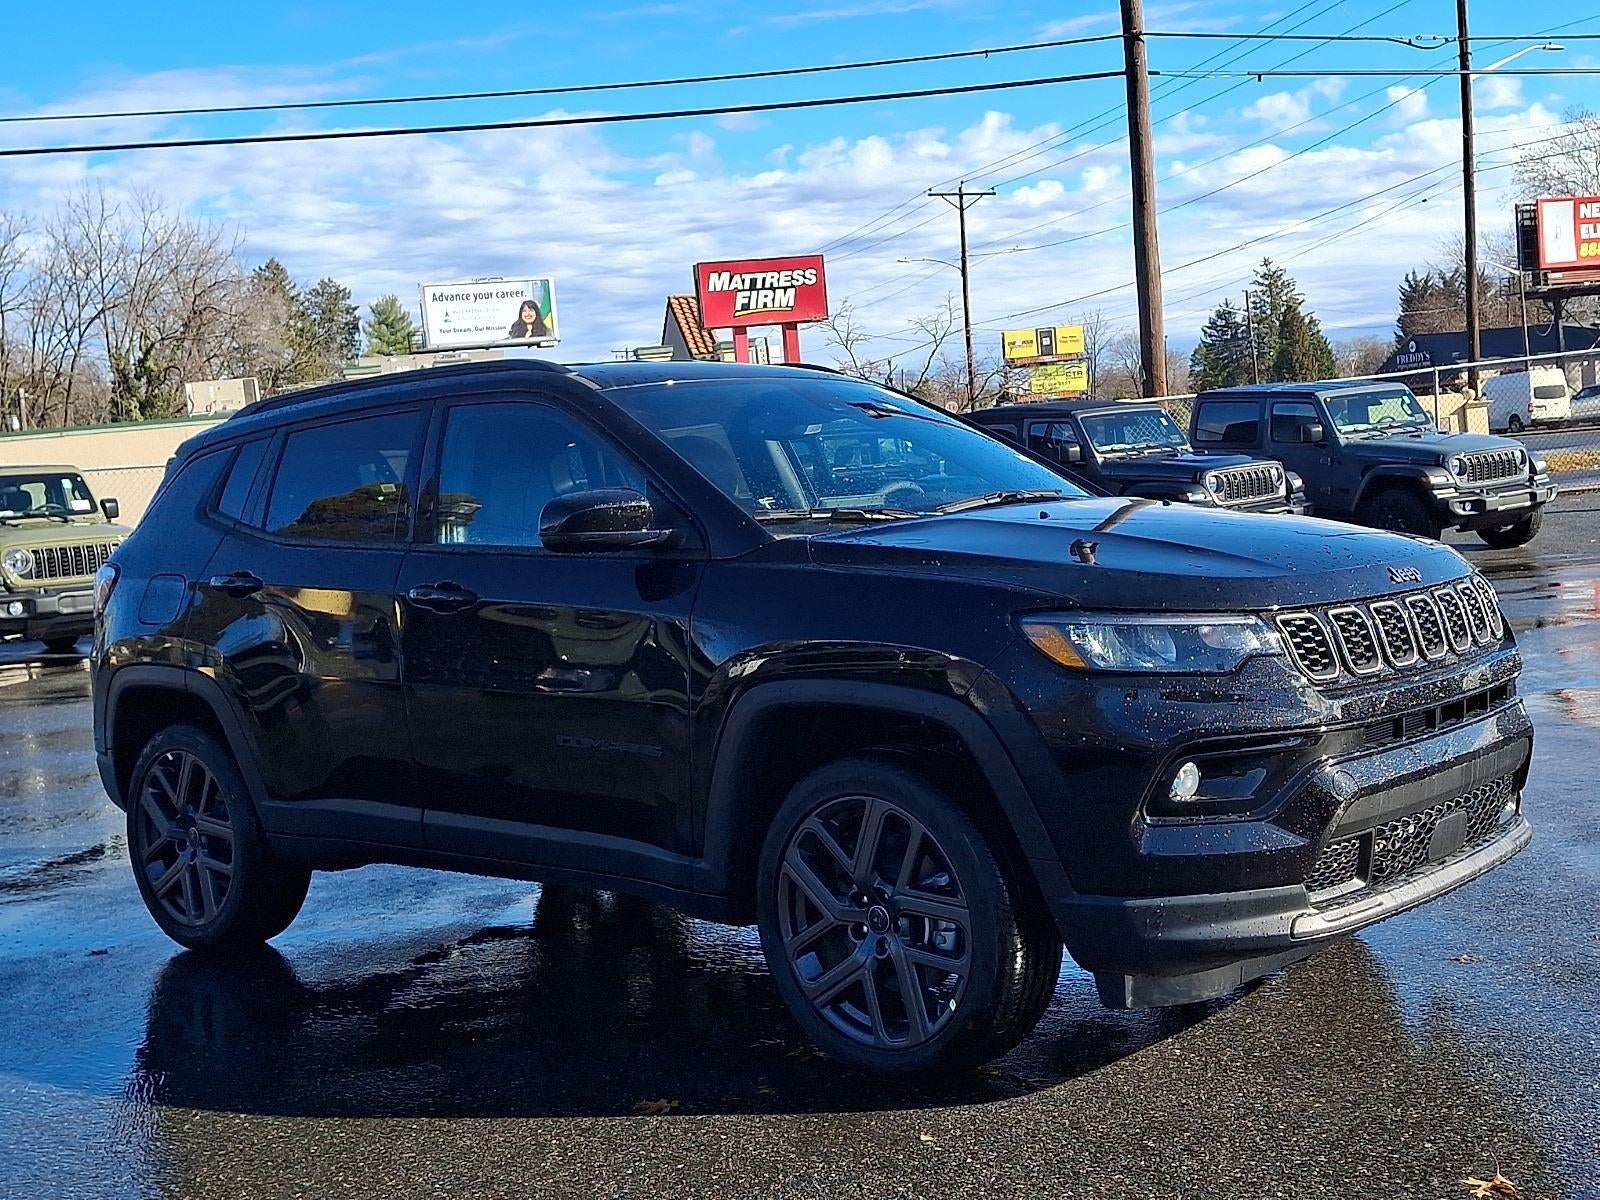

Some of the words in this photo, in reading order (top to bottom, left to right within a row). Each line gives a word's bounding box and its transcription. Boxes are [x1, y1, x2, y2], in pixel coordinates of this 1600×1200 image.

[708, 268, 817, 292] MATTRESS
[432, 291, 471, 303] Advance
[473, 291, 493, 303] your
[496, 289, 528, 299] career.
[734, 287, 796, 311] FIRM
[1396, 352, 1430, 364] FREDDY'S
[1386, 566, 1422, 584] Jeep
